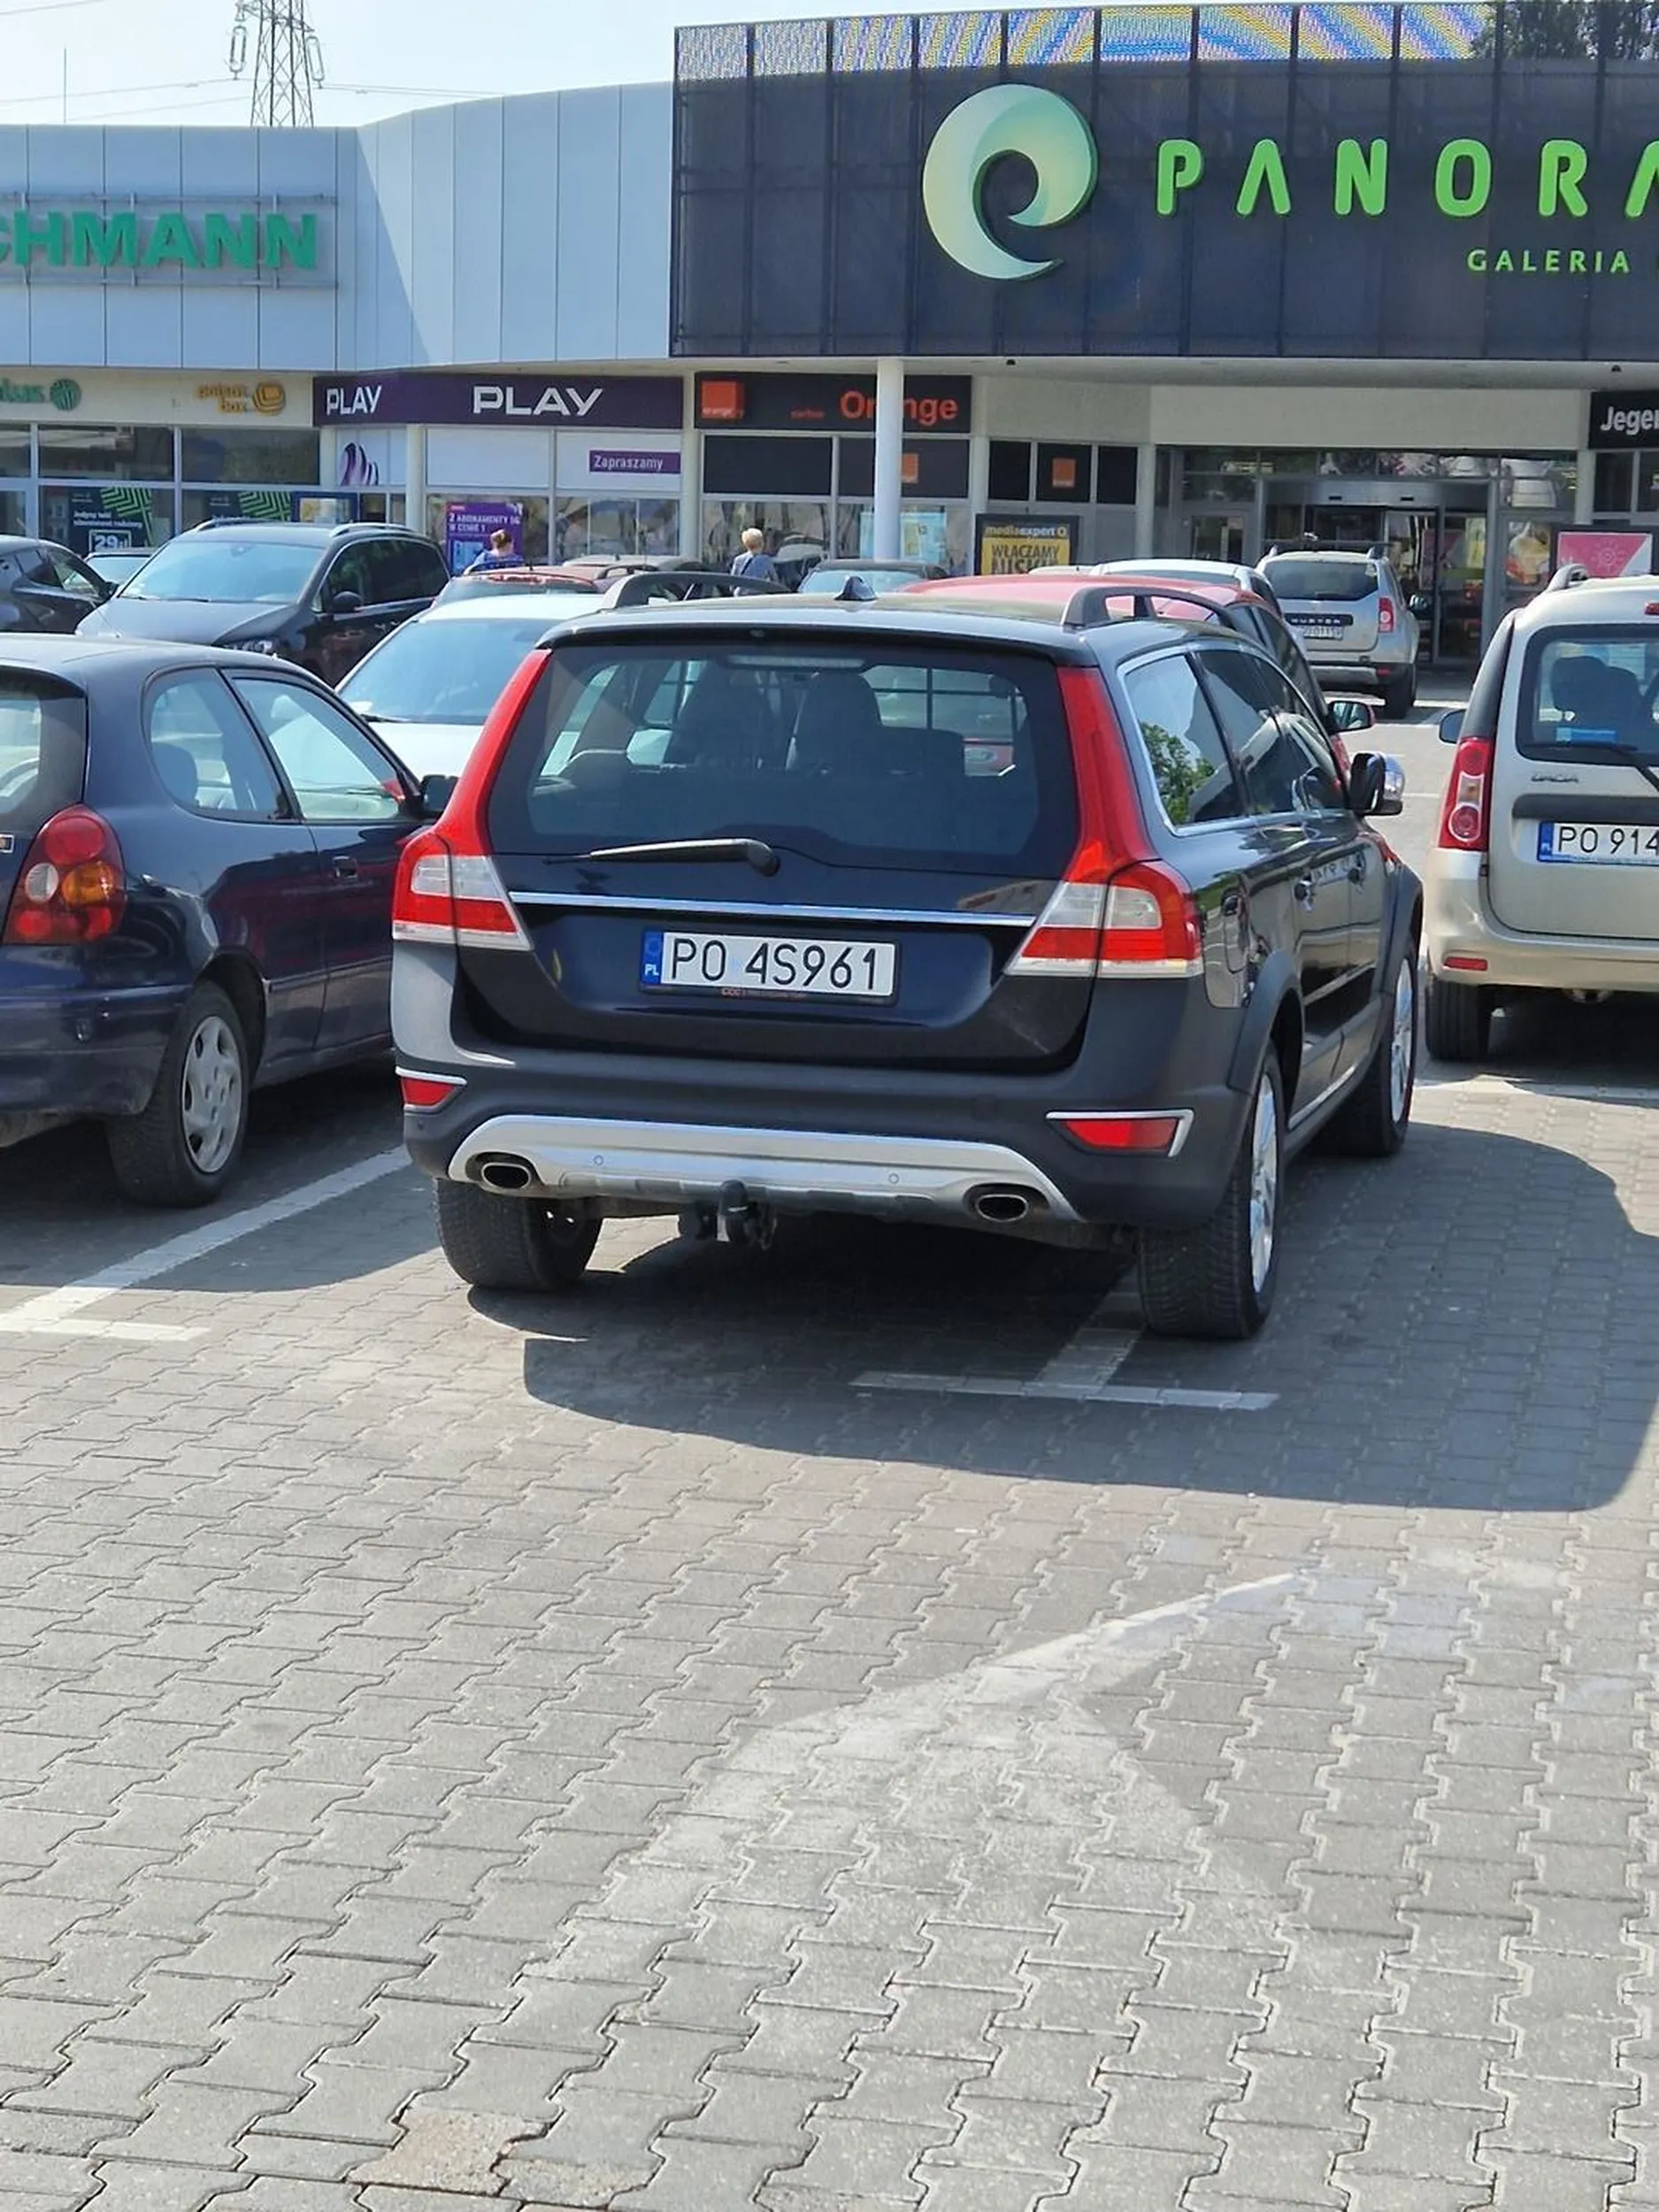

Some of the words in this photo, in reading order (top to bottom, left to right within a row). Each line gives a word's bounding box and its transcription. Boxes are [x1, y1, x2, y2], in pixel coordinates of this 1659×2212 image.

[0, 210, 317, 270] HMANN
[1467, 249, 1631, 273] GALERIA
[326, 385, 382, 415] PLAY
[472, 386, 603, 417] PLAY
[840, 389, 959, 426] Ornge
[593, 453, 664, 472] Zapraszamy
[1558, 826, 1599, 853] PO
[644, 963, 660, 976] PL
[672, 938, 726, 981] PO
[744, 941, 876, 990] 4S961
